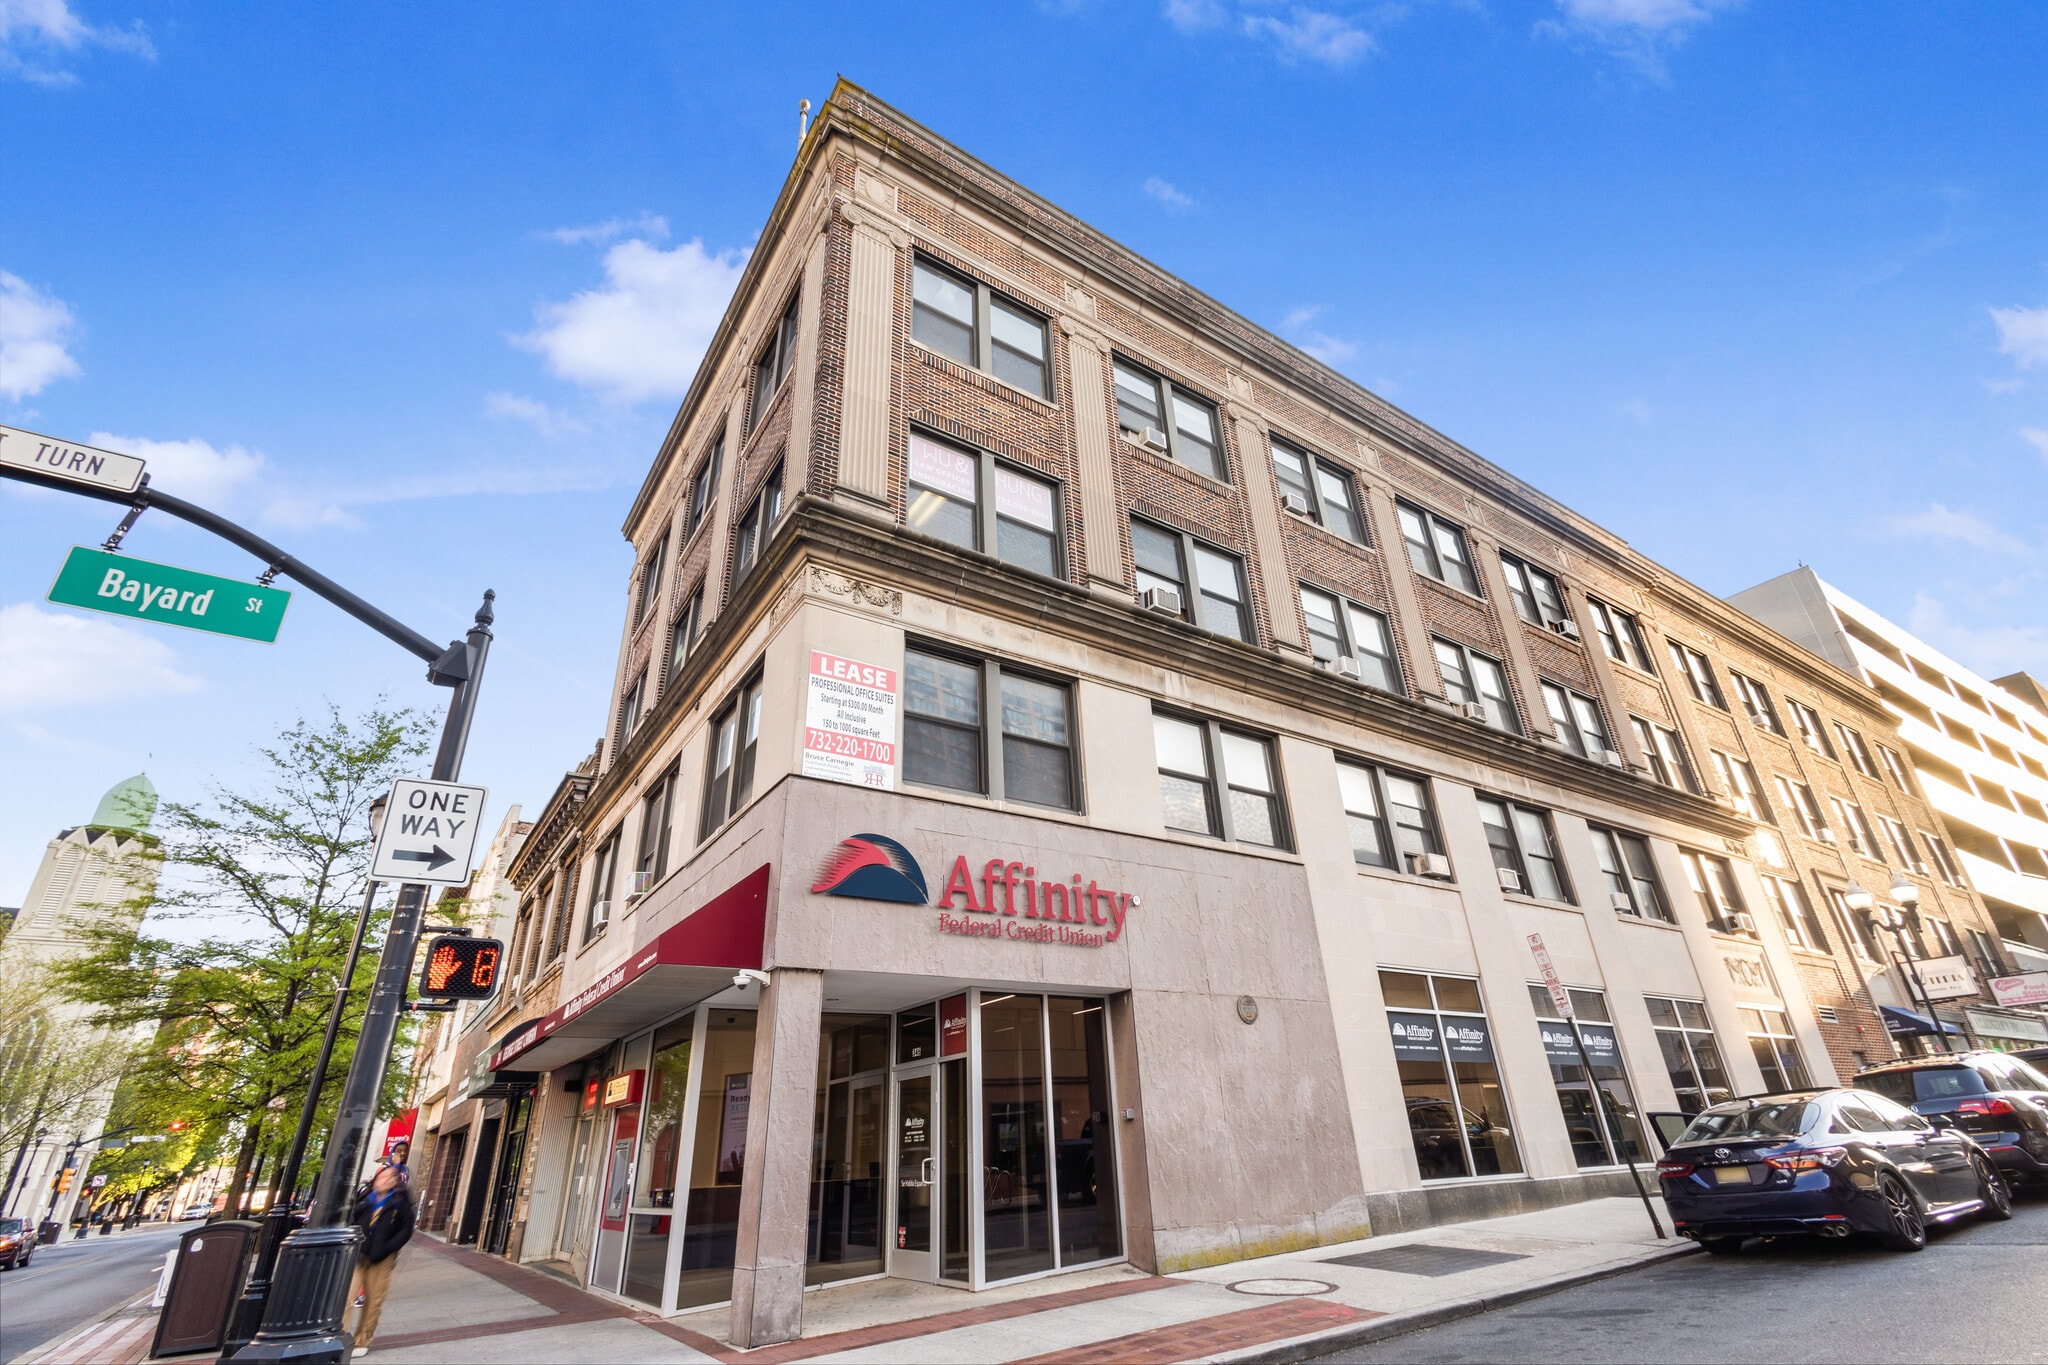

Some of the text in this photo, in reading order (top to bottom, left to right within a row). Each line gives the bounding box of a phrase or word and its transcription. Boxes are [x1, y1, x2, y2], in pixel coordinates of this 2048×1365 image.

[34, 443, 105, 476] TURN
[923, 443, 1043, 503] WU & HUNG
[97, 568, 264, 616] Bayard St
[820, 656, 888, 689] LEASE
[811, 676, 894, 705] PROFESSIONAL OFFICE SUITES
[820, 693, 842, 708] Starting
[842, 698, 848, 708] at
[868, 703, 884, 715] Month
[822, 718, 881, 739] 150 to 1000 square Feet
[837, 709, 867, 725] All Inclusive
[805, 751, 855, 767] Bruce Carnegie
[809, 730, 891, 762] 732-220-1700
[409, 789, 470, 815] ONE
[401, 814, 466, 840] WAY
[938, 855, 1132, 942] Affinity
[939, 912, 1105, 948] Federal Credit Union
[1406, 1024, 1434, 1040] Affinity
[1458, 1027, 1484, 1043] Affinity
